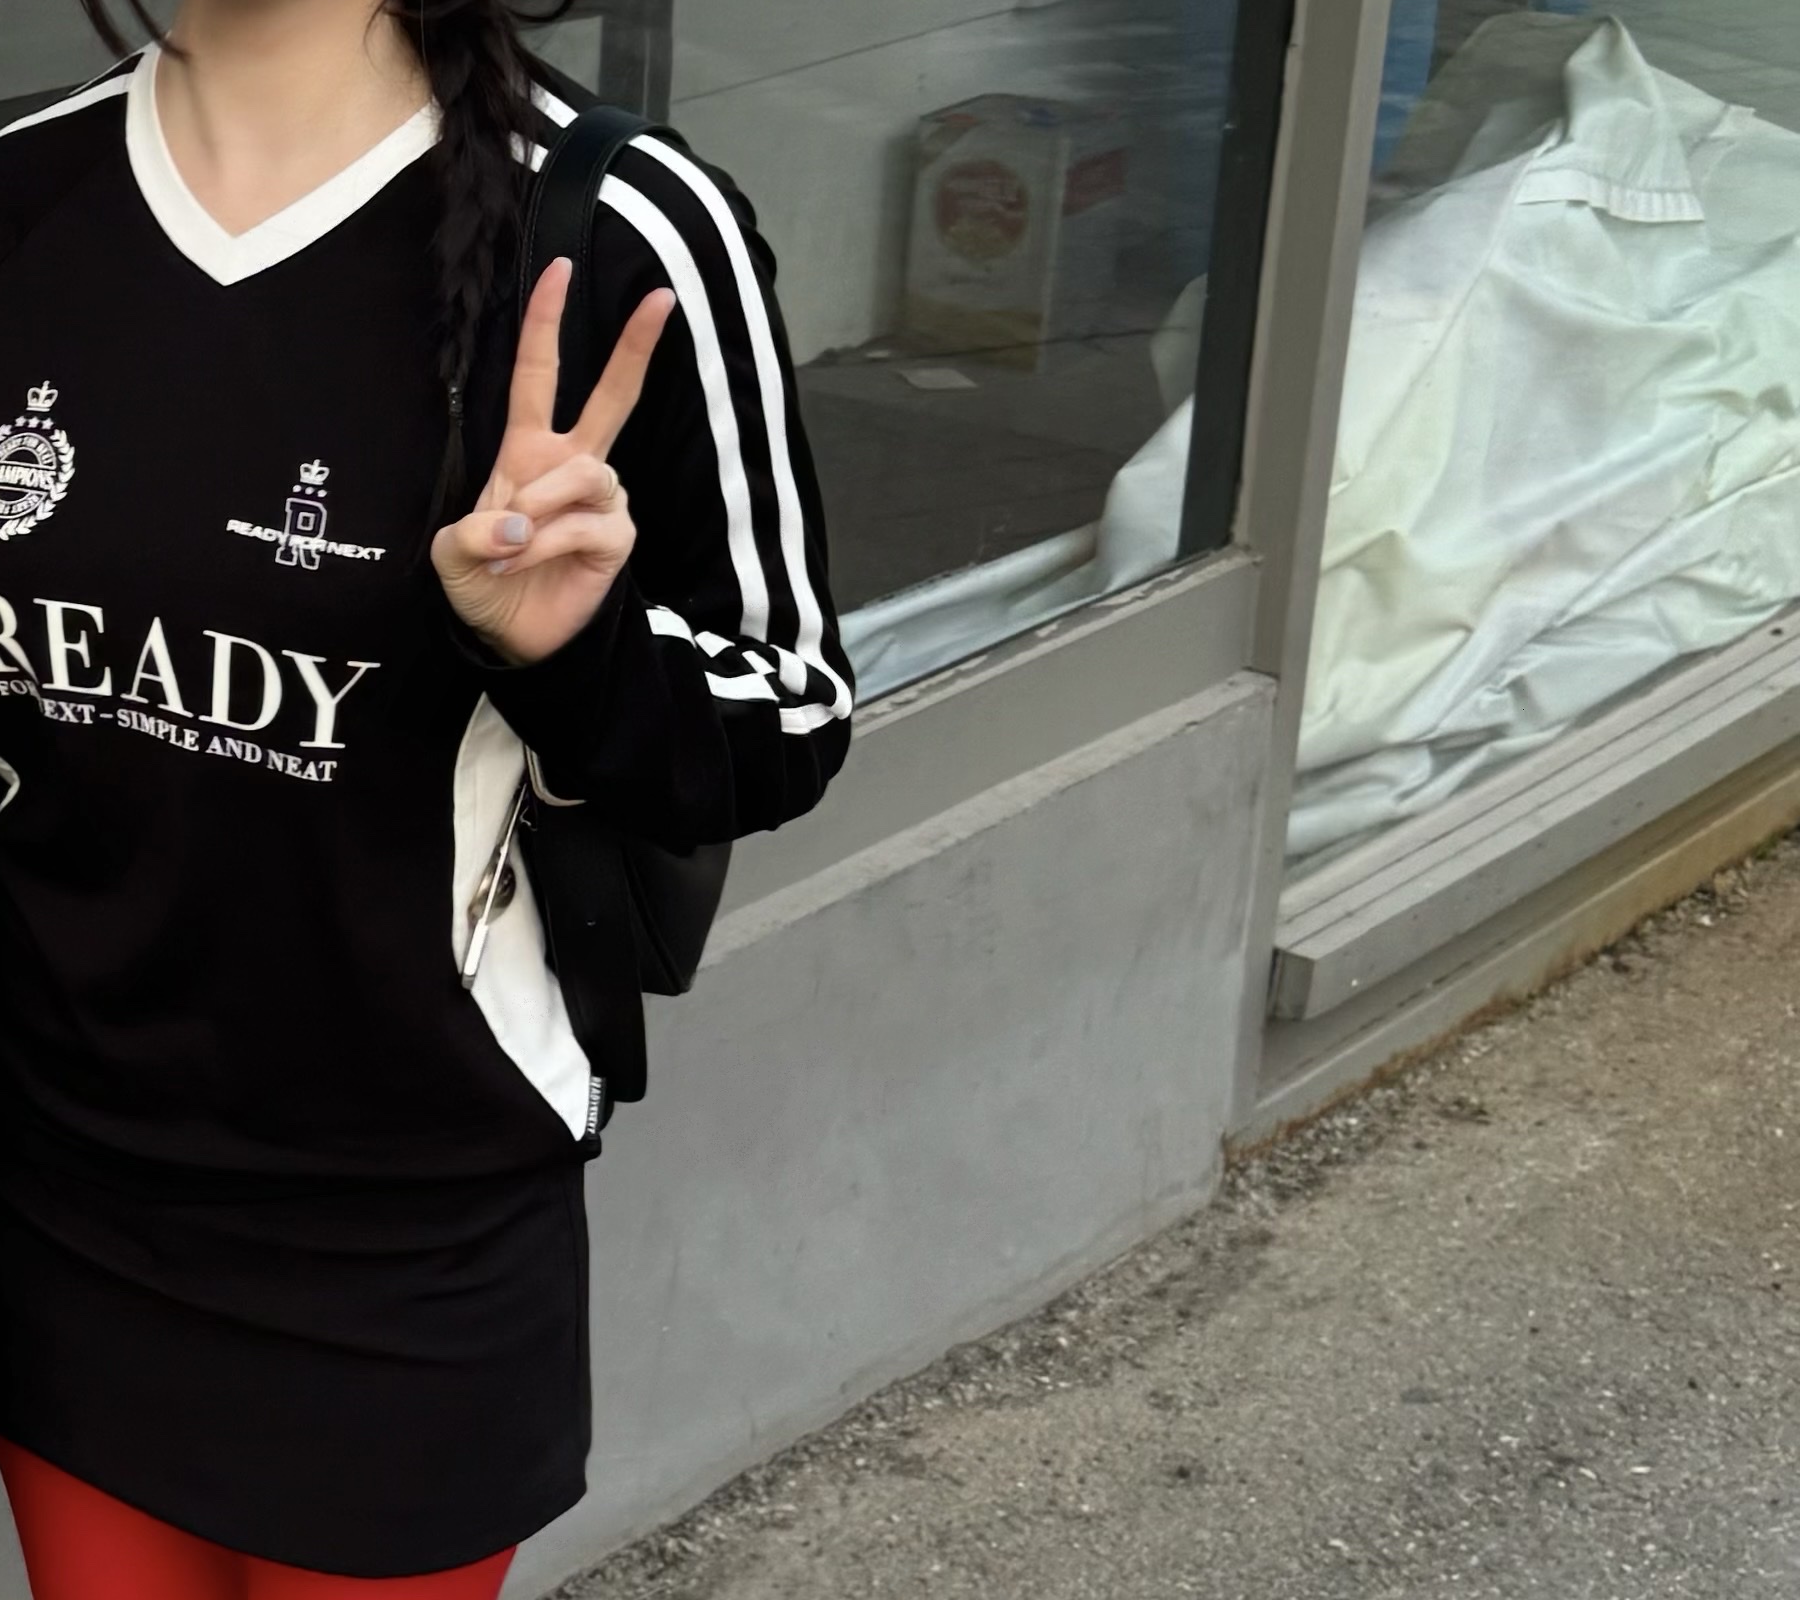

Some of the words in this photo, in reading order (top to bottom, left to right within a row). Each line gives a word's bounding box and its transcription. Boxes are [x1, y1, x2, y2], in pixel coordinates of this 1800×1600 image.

[226, 519, 289, 549] READY
[327, 541, 386, 560] NEXT
[116, 707, 200, 753] SIMPLE
[205, 735, 263, 766] AND
[266, 748, 338, 783] NEAT
